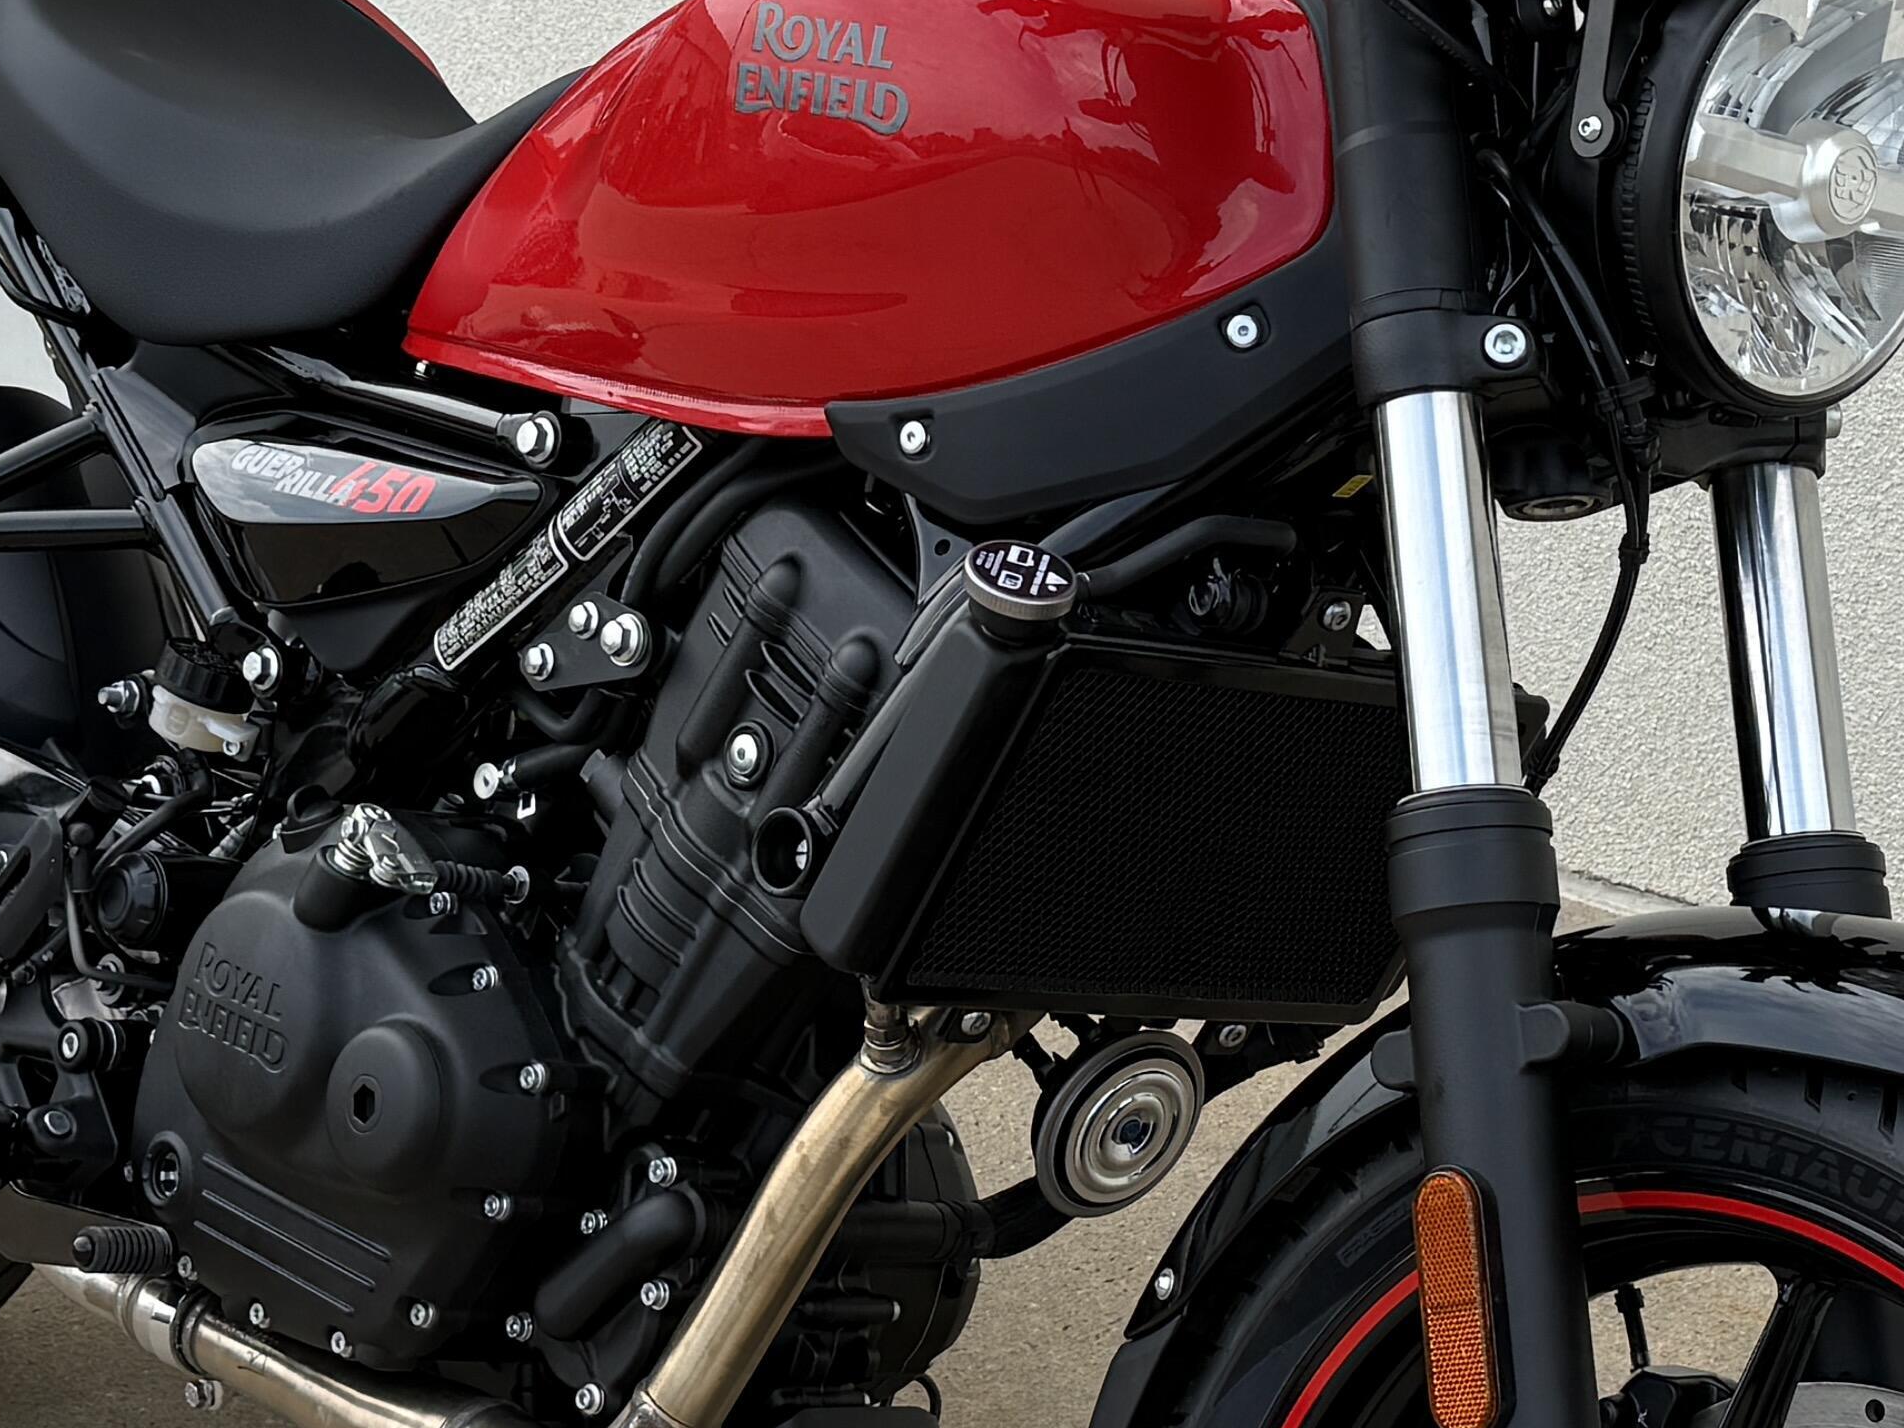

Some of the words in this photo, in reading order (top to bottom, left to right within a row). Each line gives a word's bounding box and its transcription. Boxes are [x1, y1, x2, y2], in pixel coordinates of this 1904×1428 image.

[750, 0, 894, 70] ROYAL
[734, 60, 910, 136] ENFIELD
[192, 940, 283, 1022] ROYAL
